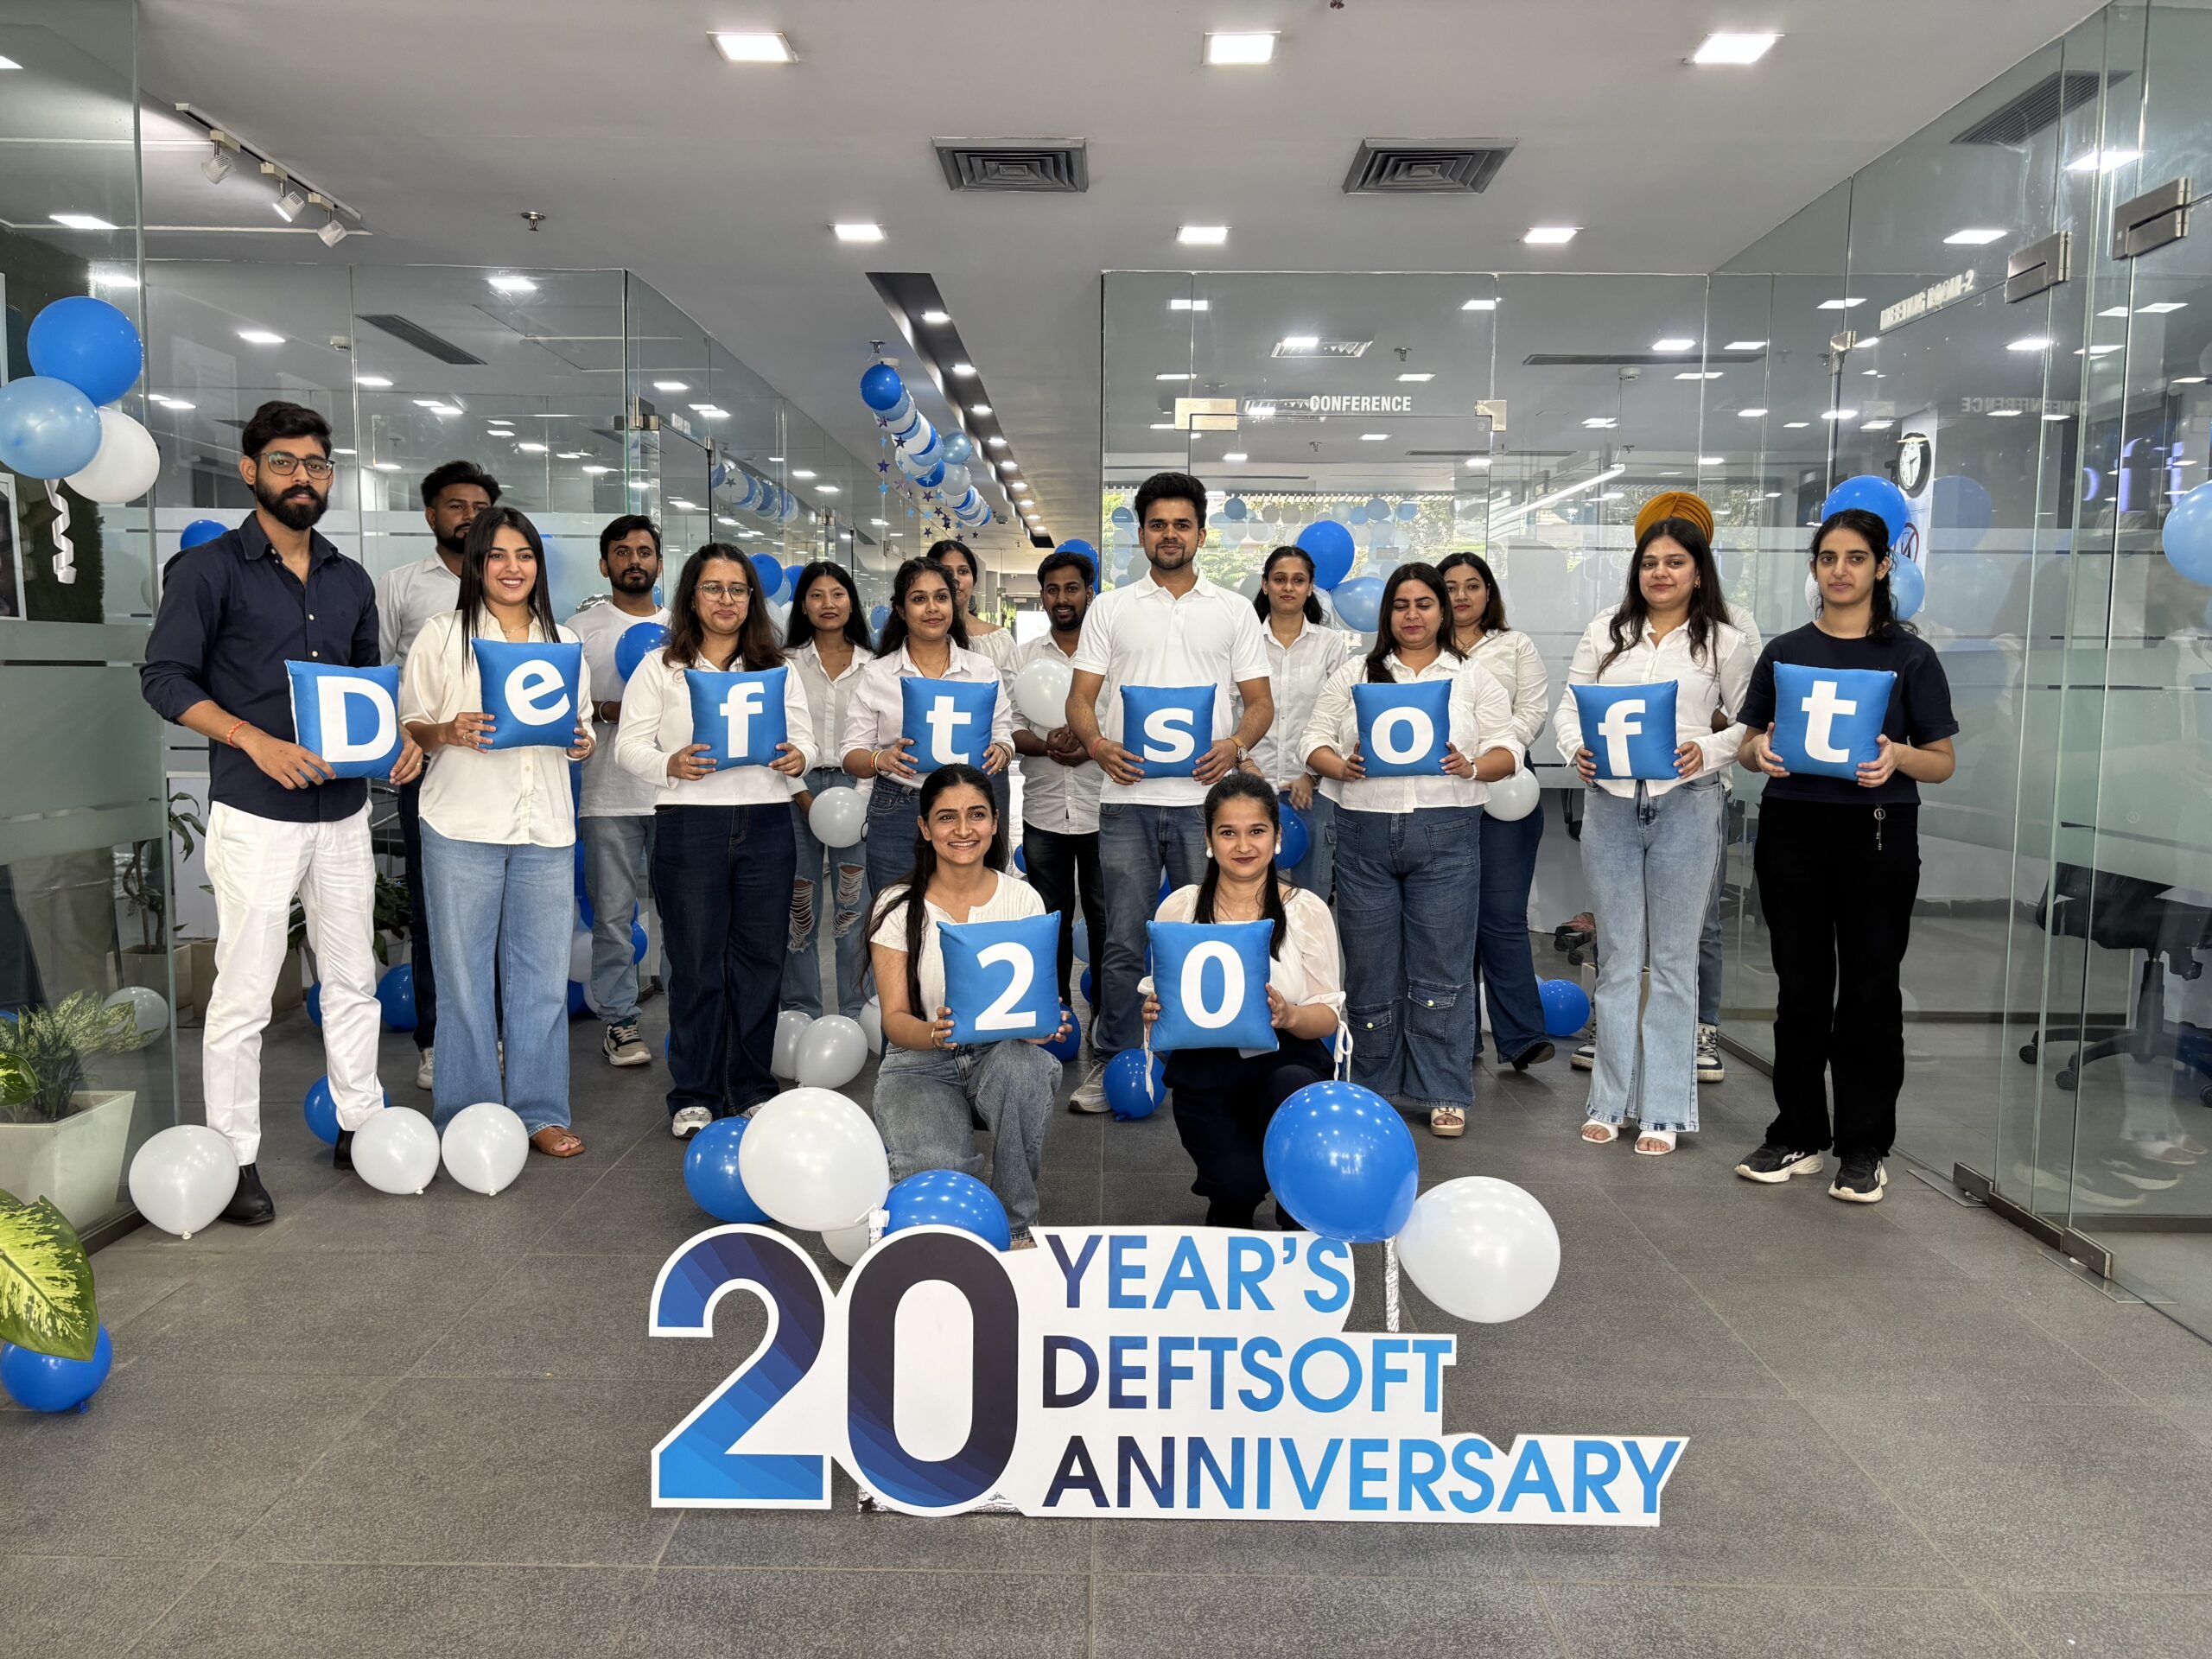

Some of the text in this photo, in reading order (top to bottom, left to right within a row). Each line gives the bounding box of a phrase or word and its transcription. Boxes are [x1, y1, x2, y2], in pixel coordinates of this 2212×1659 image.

[1309, 395, 1412, 412] CONFERENCE
[975, 941, 1037, 1031] 2
[1180, 940, 1245, 1029] 0
[1041, 1233, 1352, 1313] YEAR'S
[658, 1232, 1020, 1509] 20
[1040, 1335, 1453, 1414] DEFTSOFT
[1042, 1434, 1676, 1515] ANNIVERSARY
